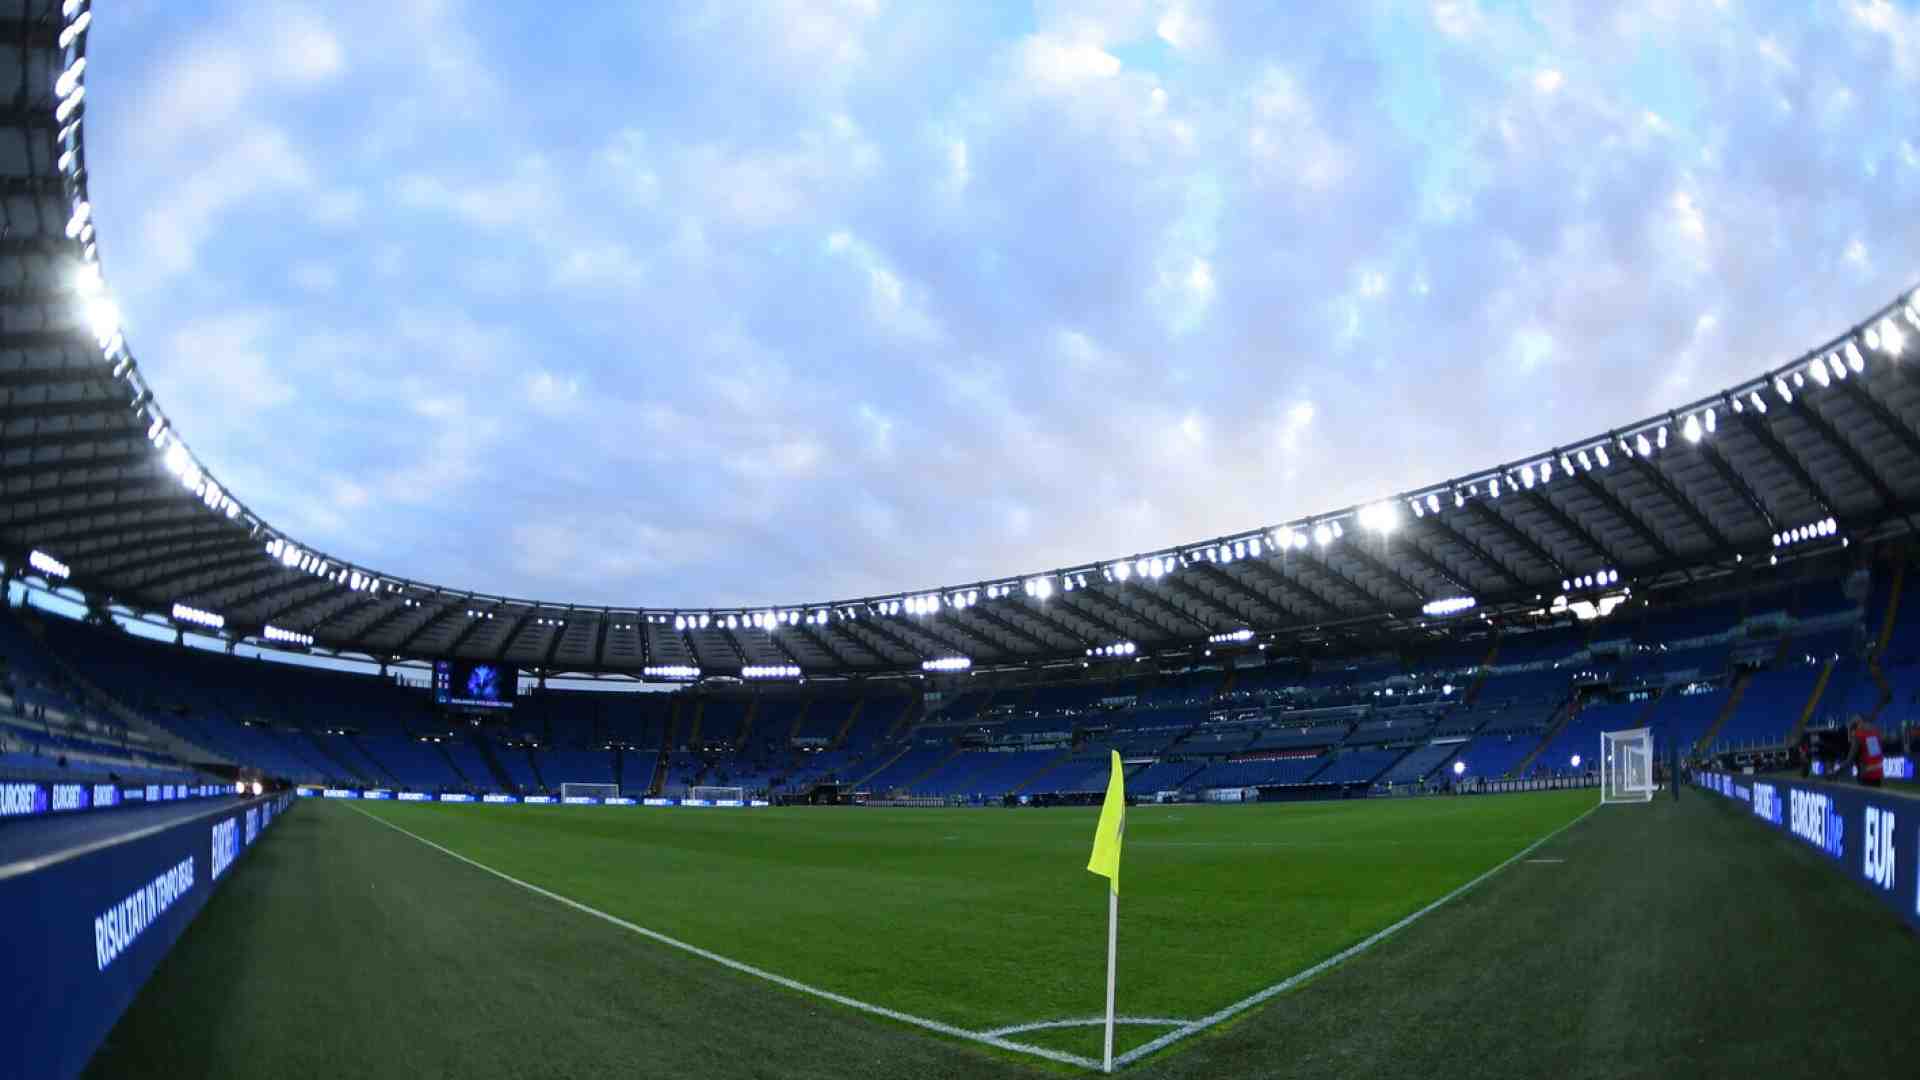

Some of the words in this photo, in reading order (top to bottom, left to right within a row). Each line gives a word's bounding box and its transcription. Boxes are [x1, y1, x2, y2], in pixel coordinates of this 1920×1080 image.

[95, 888, 147, 971] RISULTATI
[146, 881, 157, 925] IN
[155, 866, 178, 914] TEMPO
